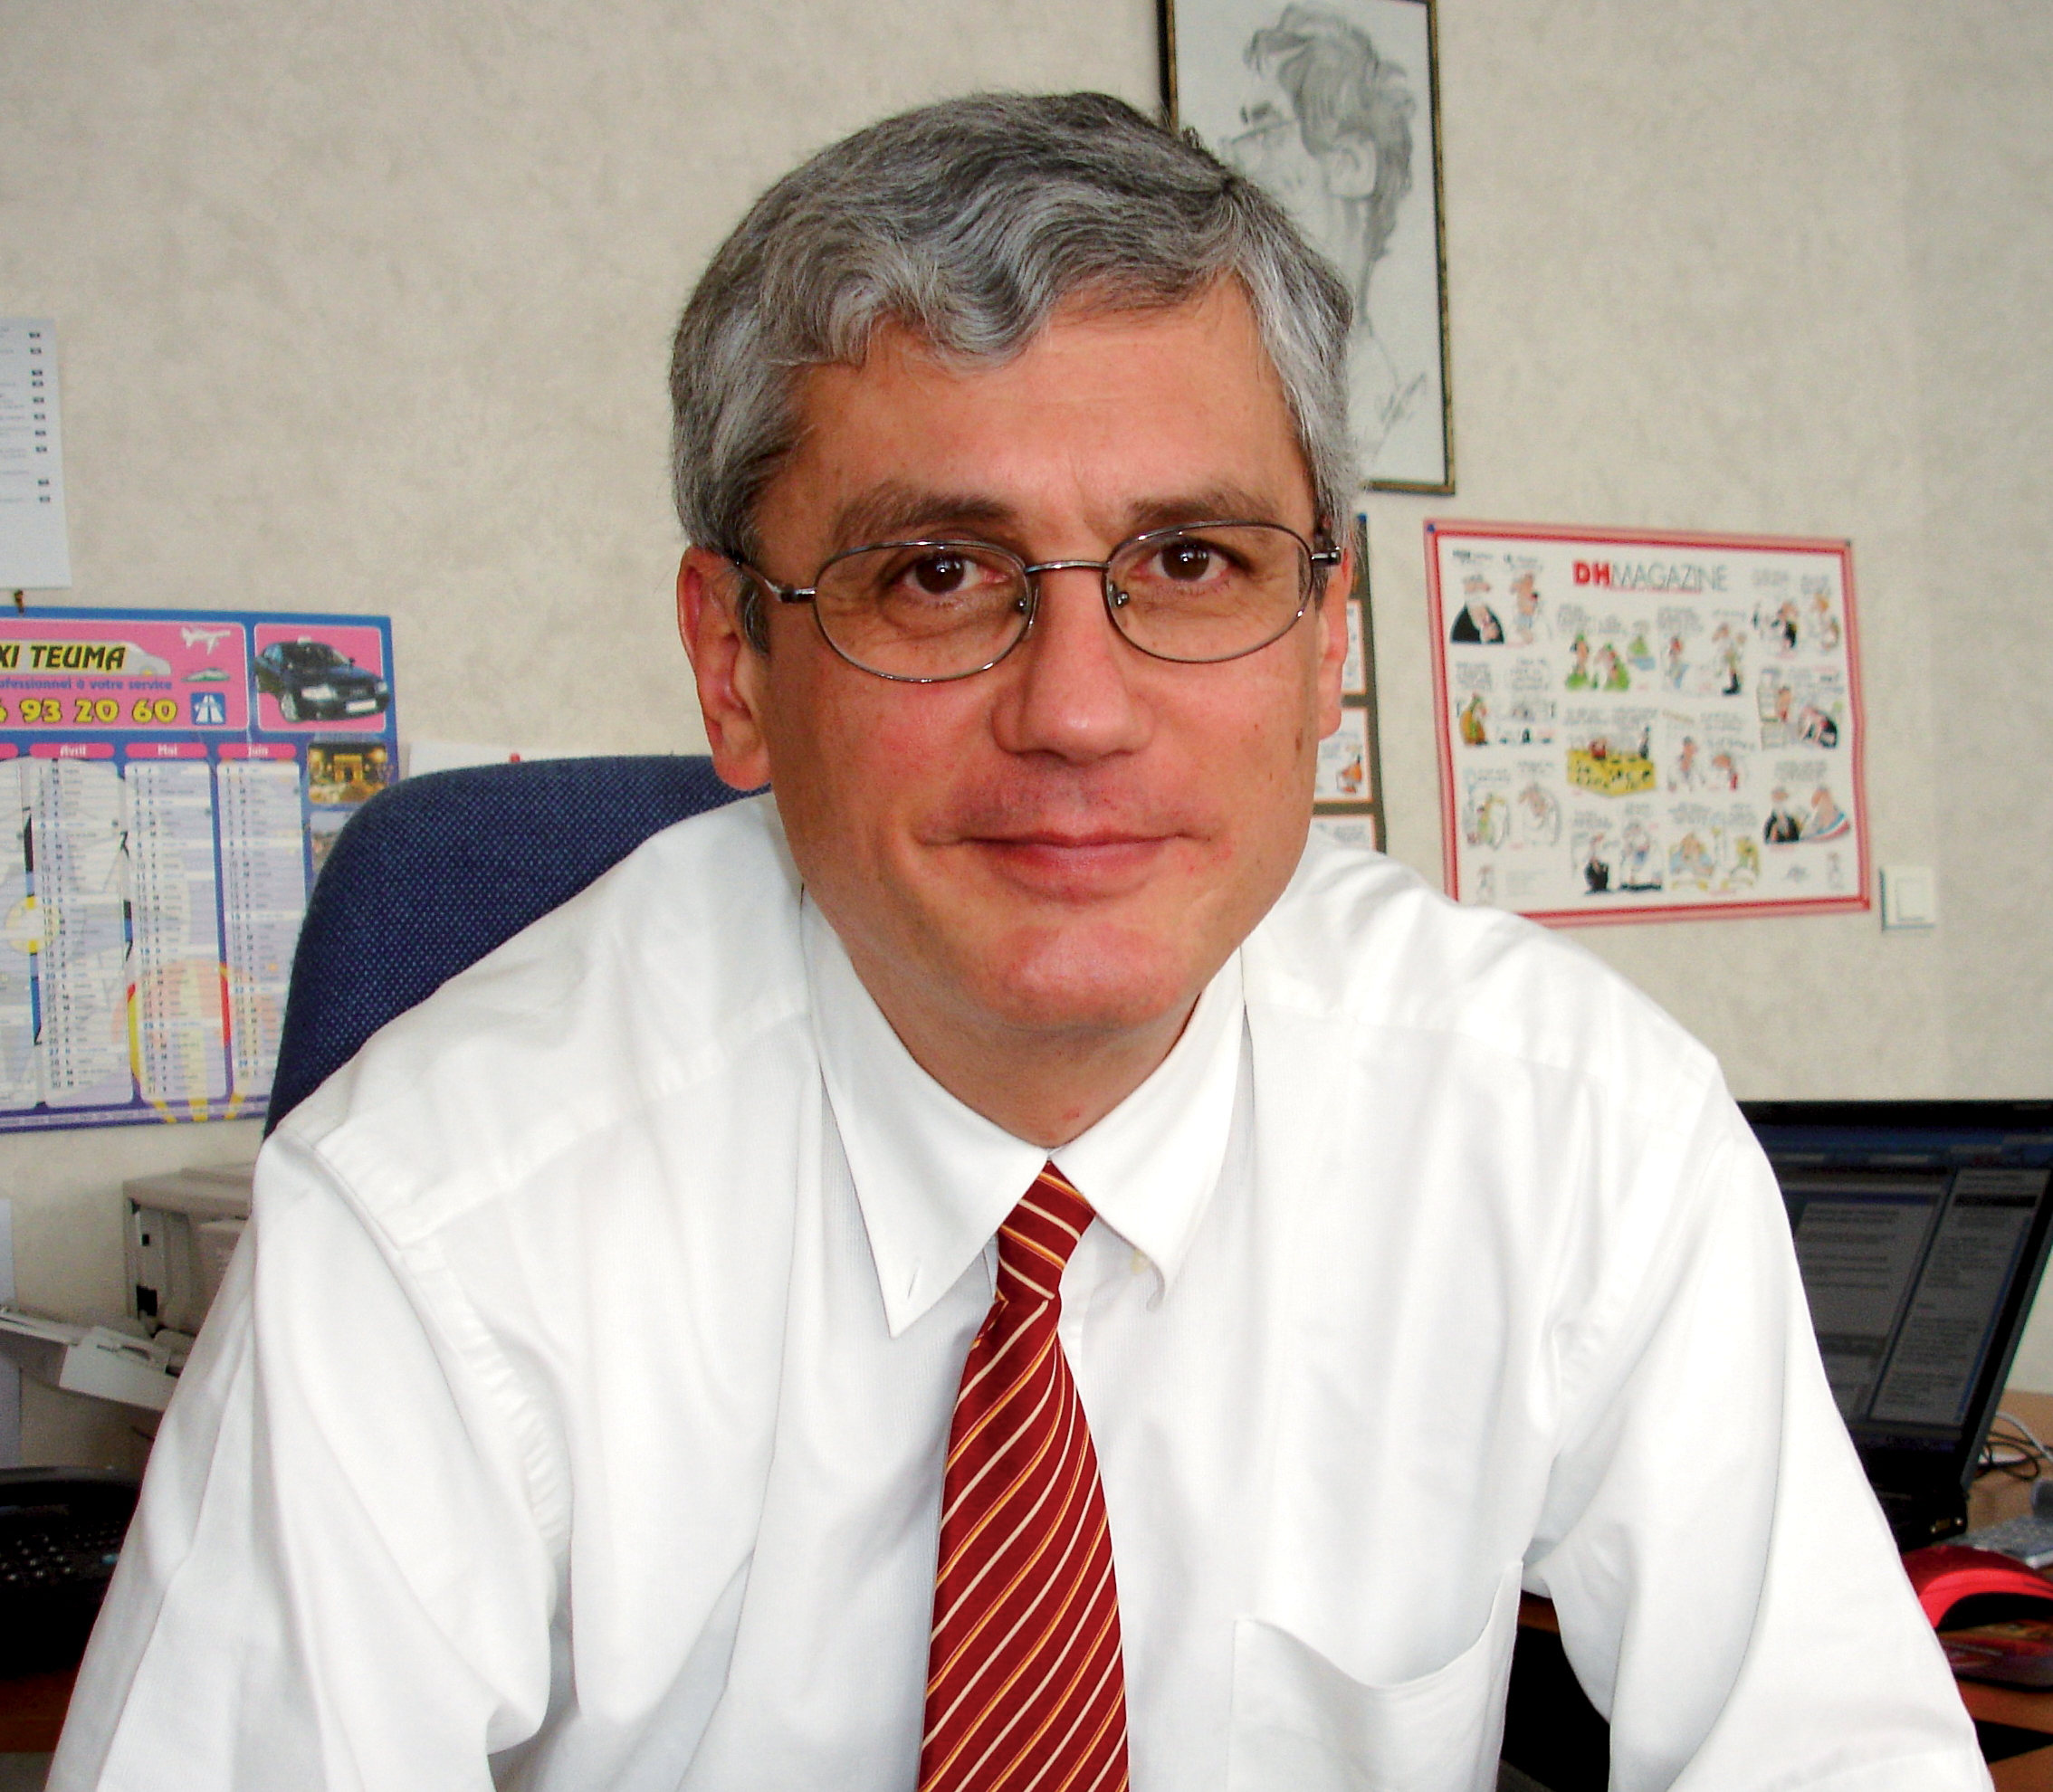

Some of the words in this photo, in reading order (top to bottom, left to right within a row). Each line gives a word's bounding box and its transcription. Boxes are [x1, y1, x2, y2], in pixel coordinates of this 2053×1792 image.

[31, 645, 125, 671] TEUMA
[90, 679, 123, 690] votre
[129, 678, 172, 691] service
[19, 698, 62, 723] 93
[74, 699, 119, 723] 20
[132, 699, 177, 723] 60
[60, 744, 87, 757] Avril
[158, 743, 177, 757] Mai
